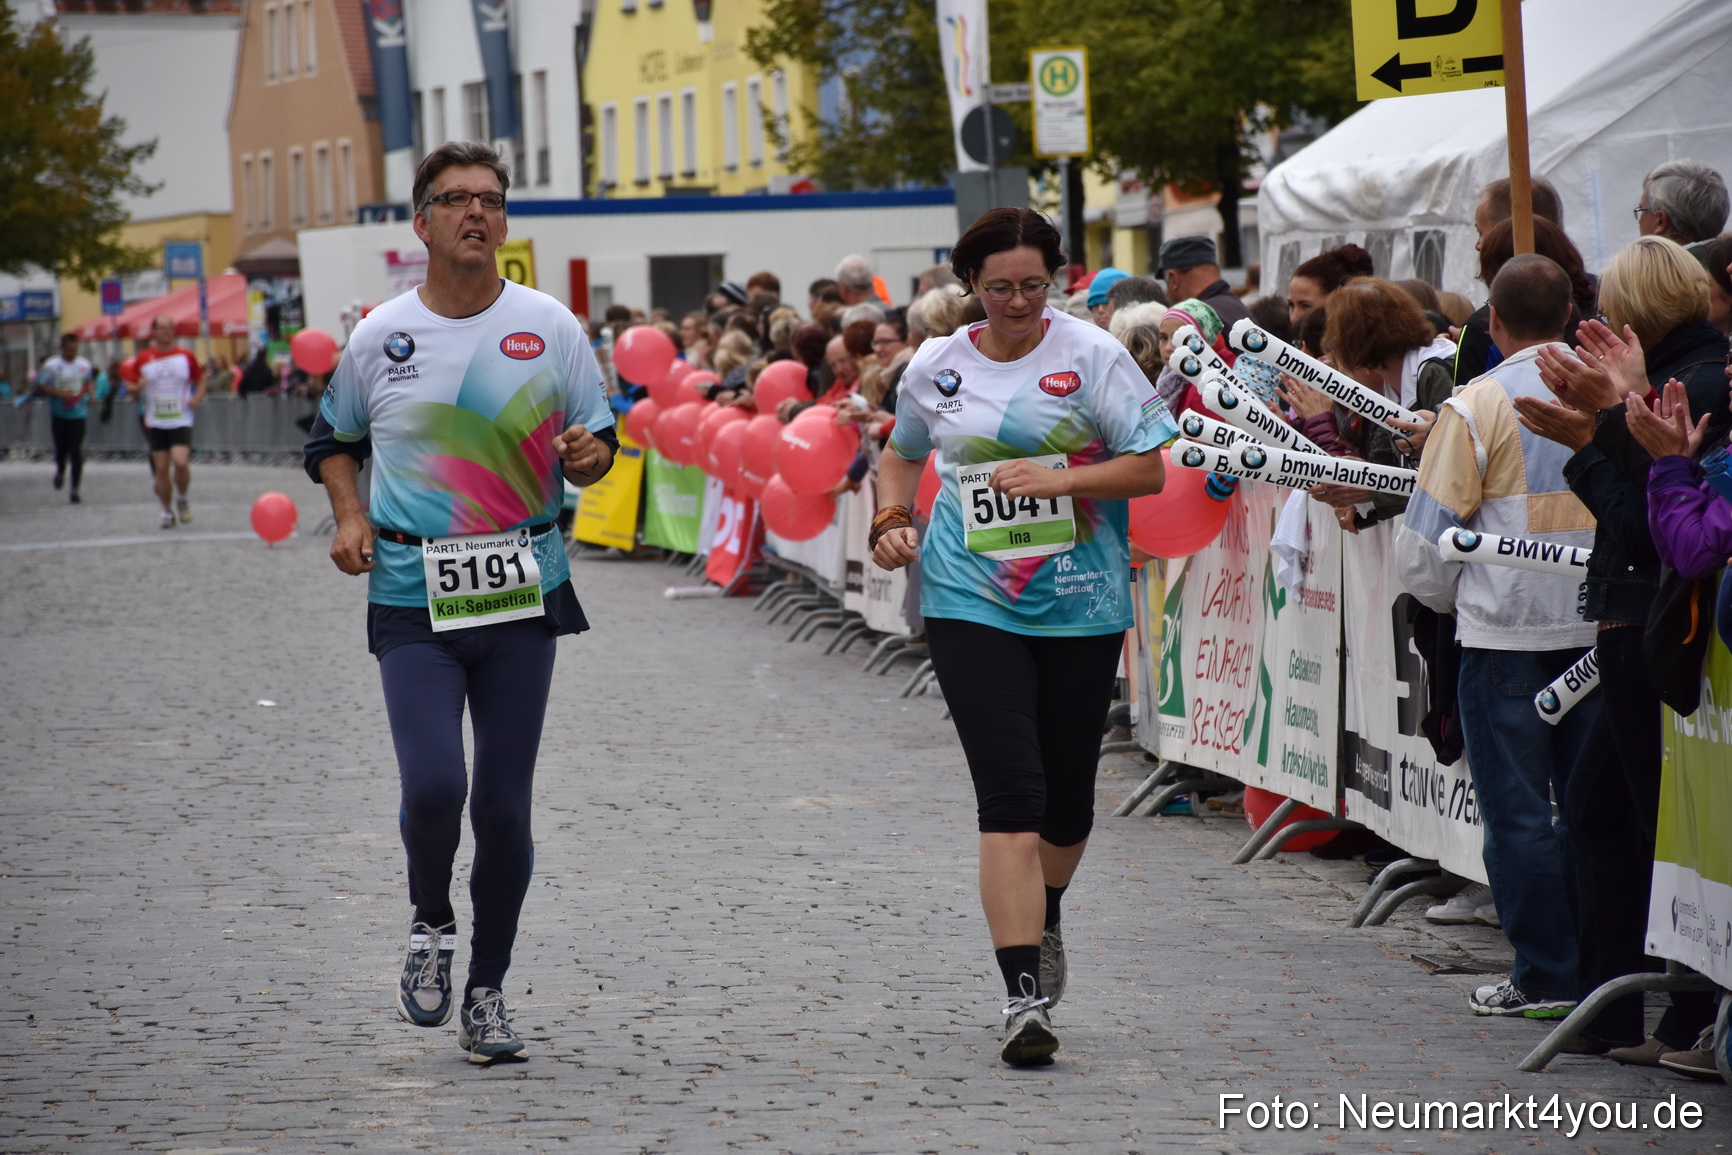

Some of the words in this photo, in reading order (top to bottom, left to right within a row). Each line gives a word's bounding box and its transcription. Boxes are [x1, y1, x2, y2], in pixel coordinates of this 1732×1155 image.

[506, 339, 540, 353] Hervis
[388, 364, 419, 376] PARTL
[387, 373, 419, 383] Neumarkt
[1045, 377, 1076, 390] Hervis
[1276, 347, 1417, 436] bmw-laufsport
[936, 400, 963, 409] PARTL
[1246, 407, 1290, 443] BMW
[1009, 530, 1031, 544] Ina
[426, 543, 463, 554] PARTL
[465, 539, 515, 551] Neumarkt
[1498, 536, 1564, 563] BMW
[1054, 555, 1078, 572] 16.
[438, 552, 526, 592] 5191
[1055, 571, 1104, 584] Neumarkter
[1055, 582, 1095, 596] Stadtlauf
[436, 591, 536, 617] Kai-Sebastian
[1448, 778, 1483, 828] neu
